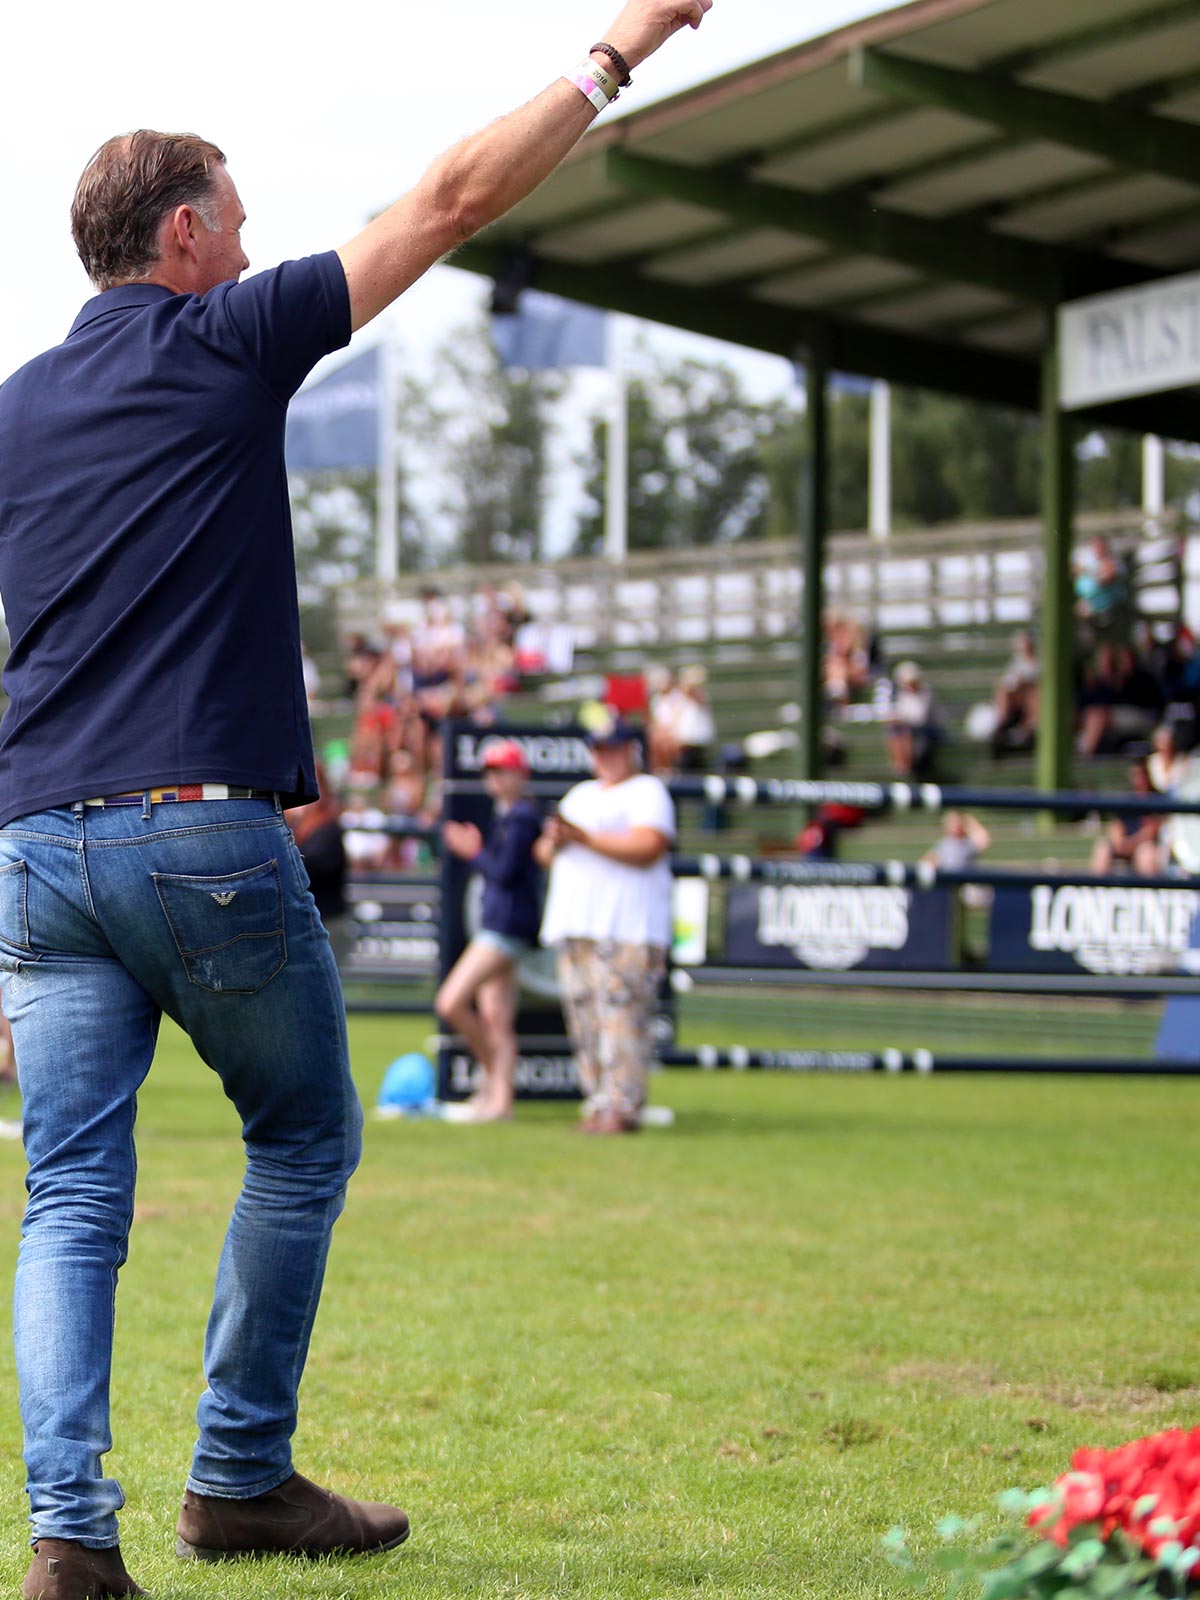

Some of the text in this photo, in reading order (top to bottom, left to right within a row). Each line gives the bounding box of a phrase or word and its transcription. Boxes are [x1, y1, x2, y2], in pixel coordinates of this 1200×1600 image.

[592, 70, 608, 85] 2018
[757, 885, 909, 949] LONGINES
[1029, 885, 1200, 951] LONGINE
